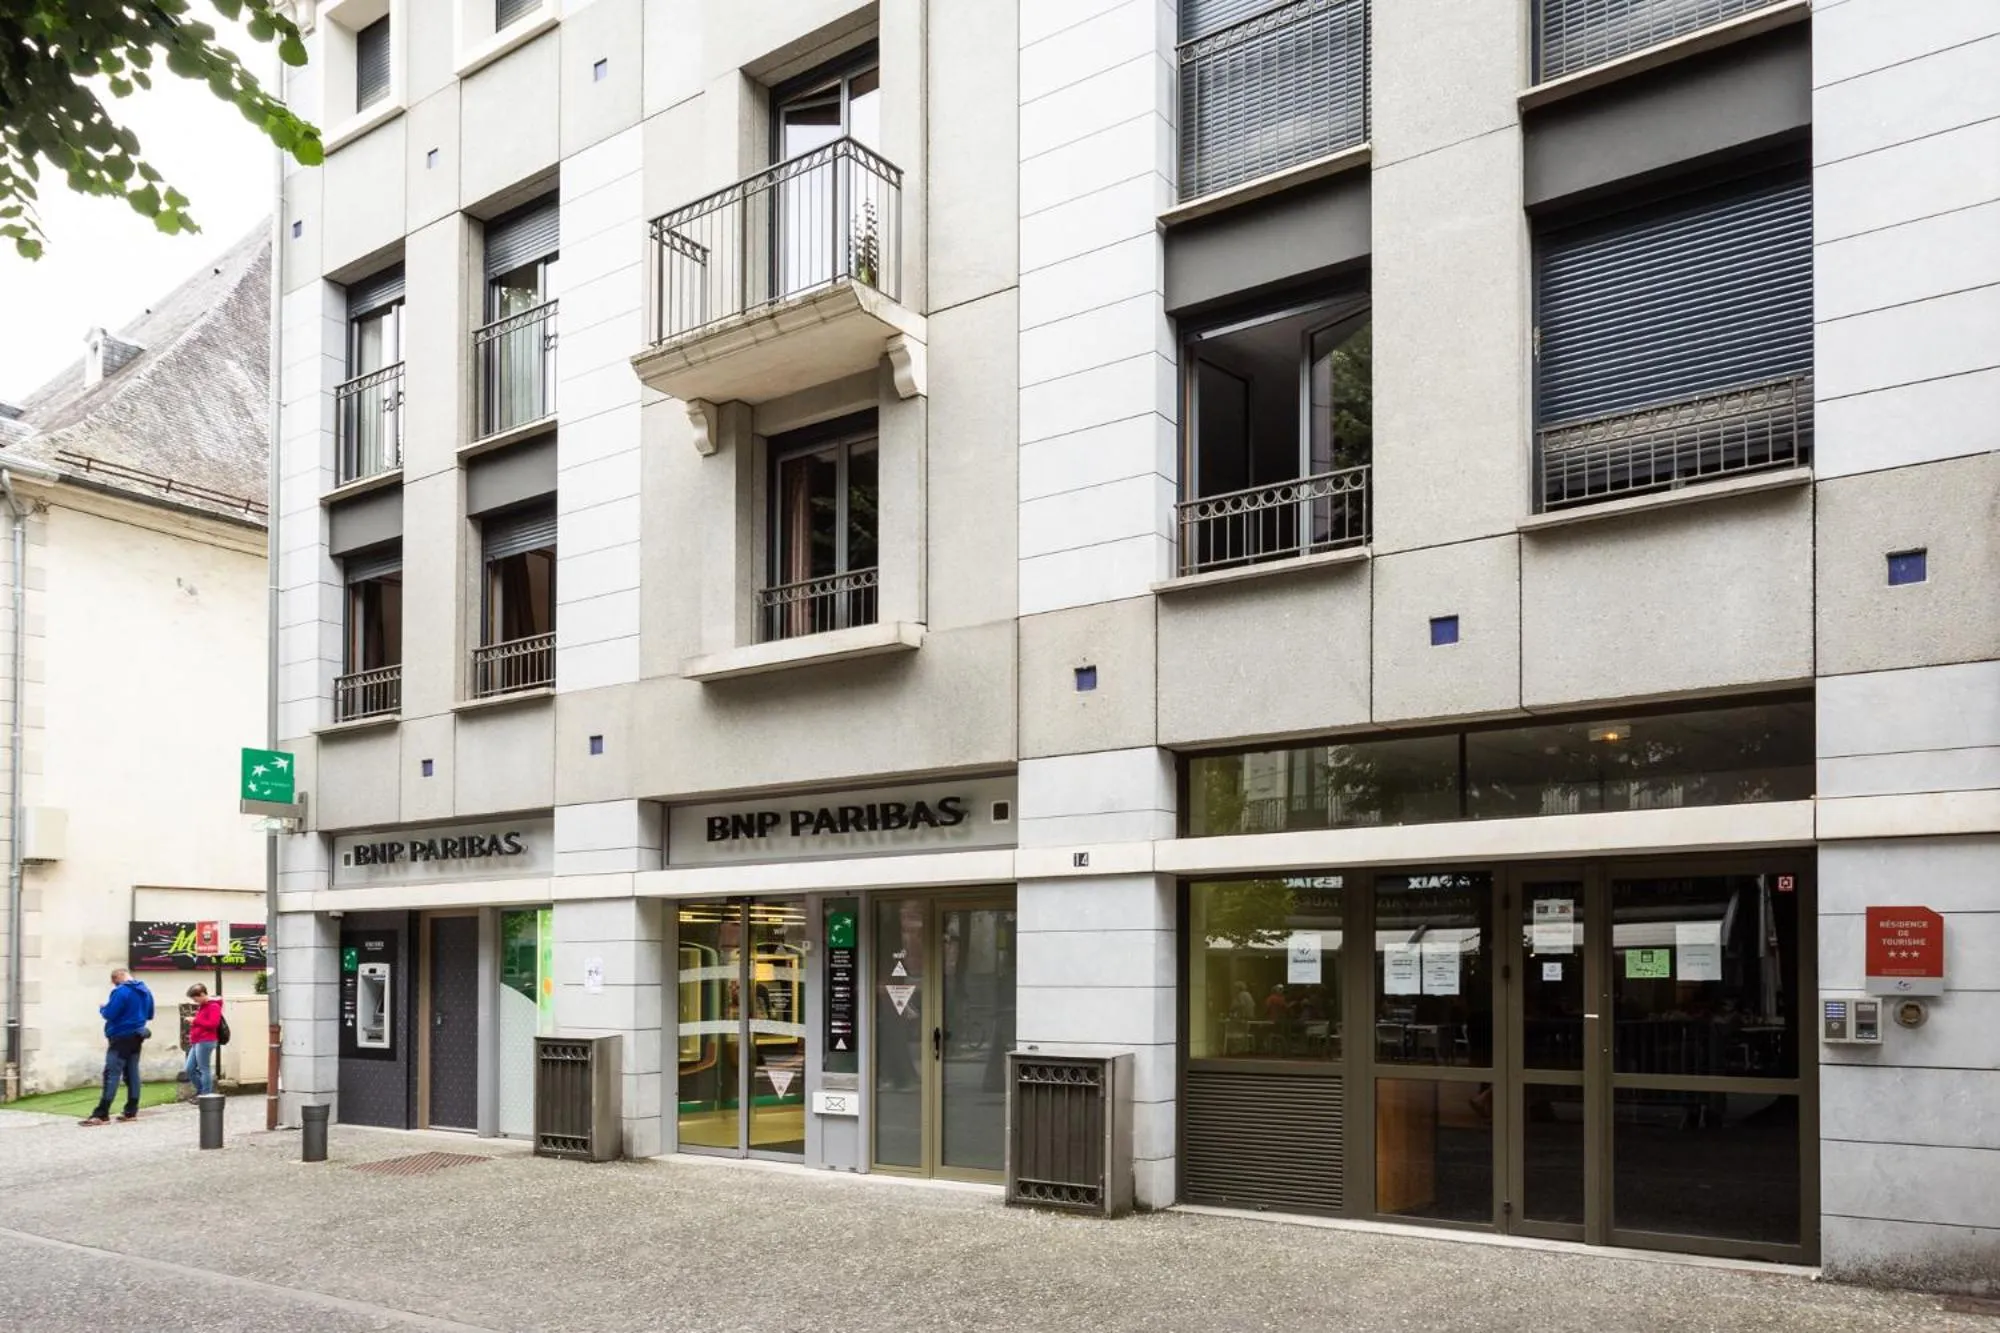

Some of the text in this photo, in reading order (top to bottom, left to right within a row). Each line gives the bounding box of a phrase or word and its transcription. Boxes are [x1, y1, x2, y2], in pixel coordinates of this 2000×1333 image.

[706, 796, 968, 842] BNP PARIBAS
[354, 831, 523, 866] BNP PARIBAS
[1075, 853, 1088, 866] 14
[1879, 920, 1929, 929] RÉSIDENCE
[1897, 929, 1910, 937] DE
[1882, 938, 1927, 946] TOURISME
